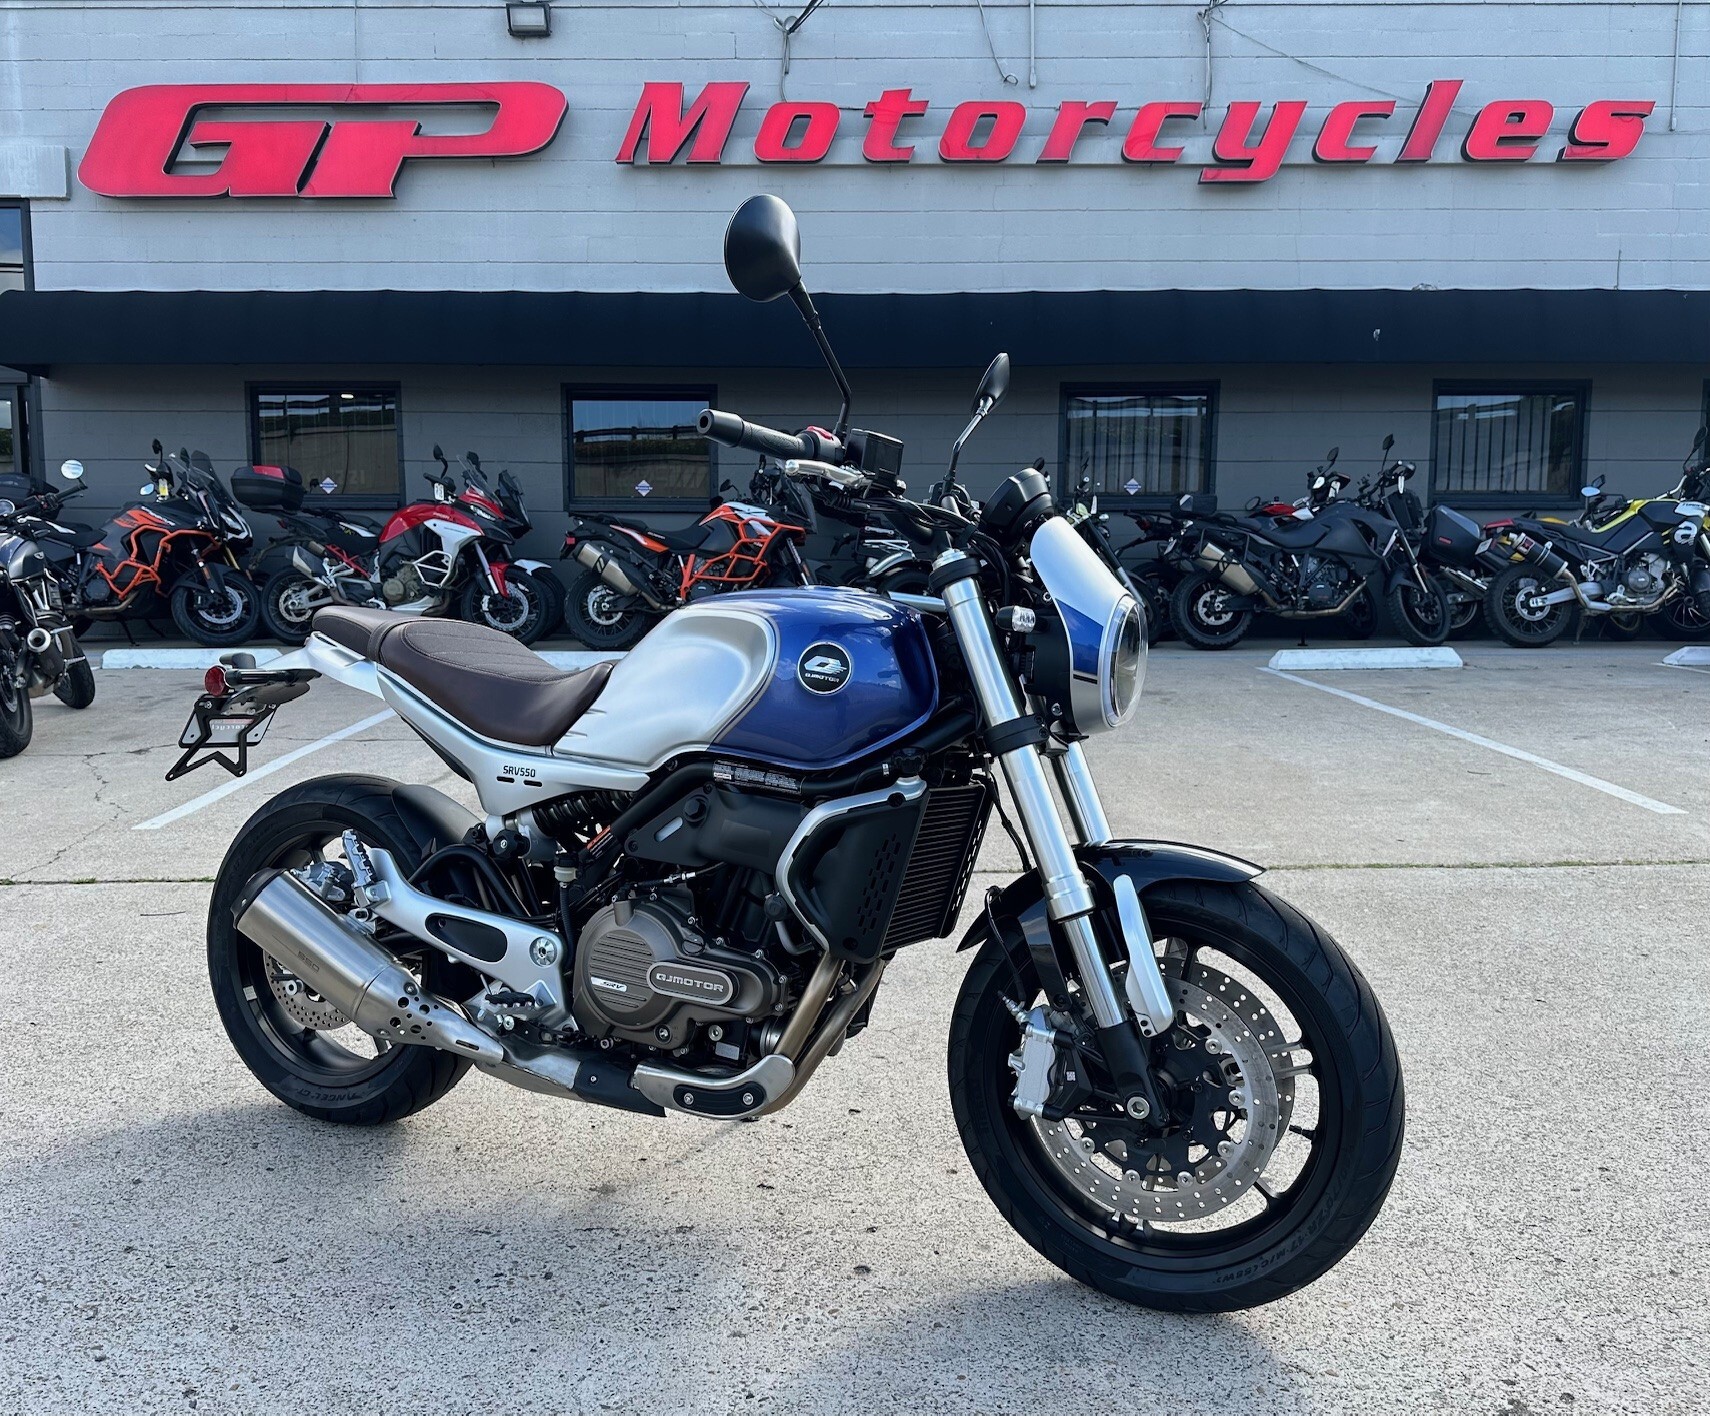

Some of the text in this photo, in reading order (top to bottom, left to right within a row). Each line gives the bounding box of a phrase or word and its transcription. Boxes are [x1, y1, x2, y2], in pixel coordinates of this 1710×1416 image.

[77, 79, 1656, 199] GP Motorcycles
[503, 765, 536, 778] SRV550
[655, 972, 724, 993] QJMOTOR
